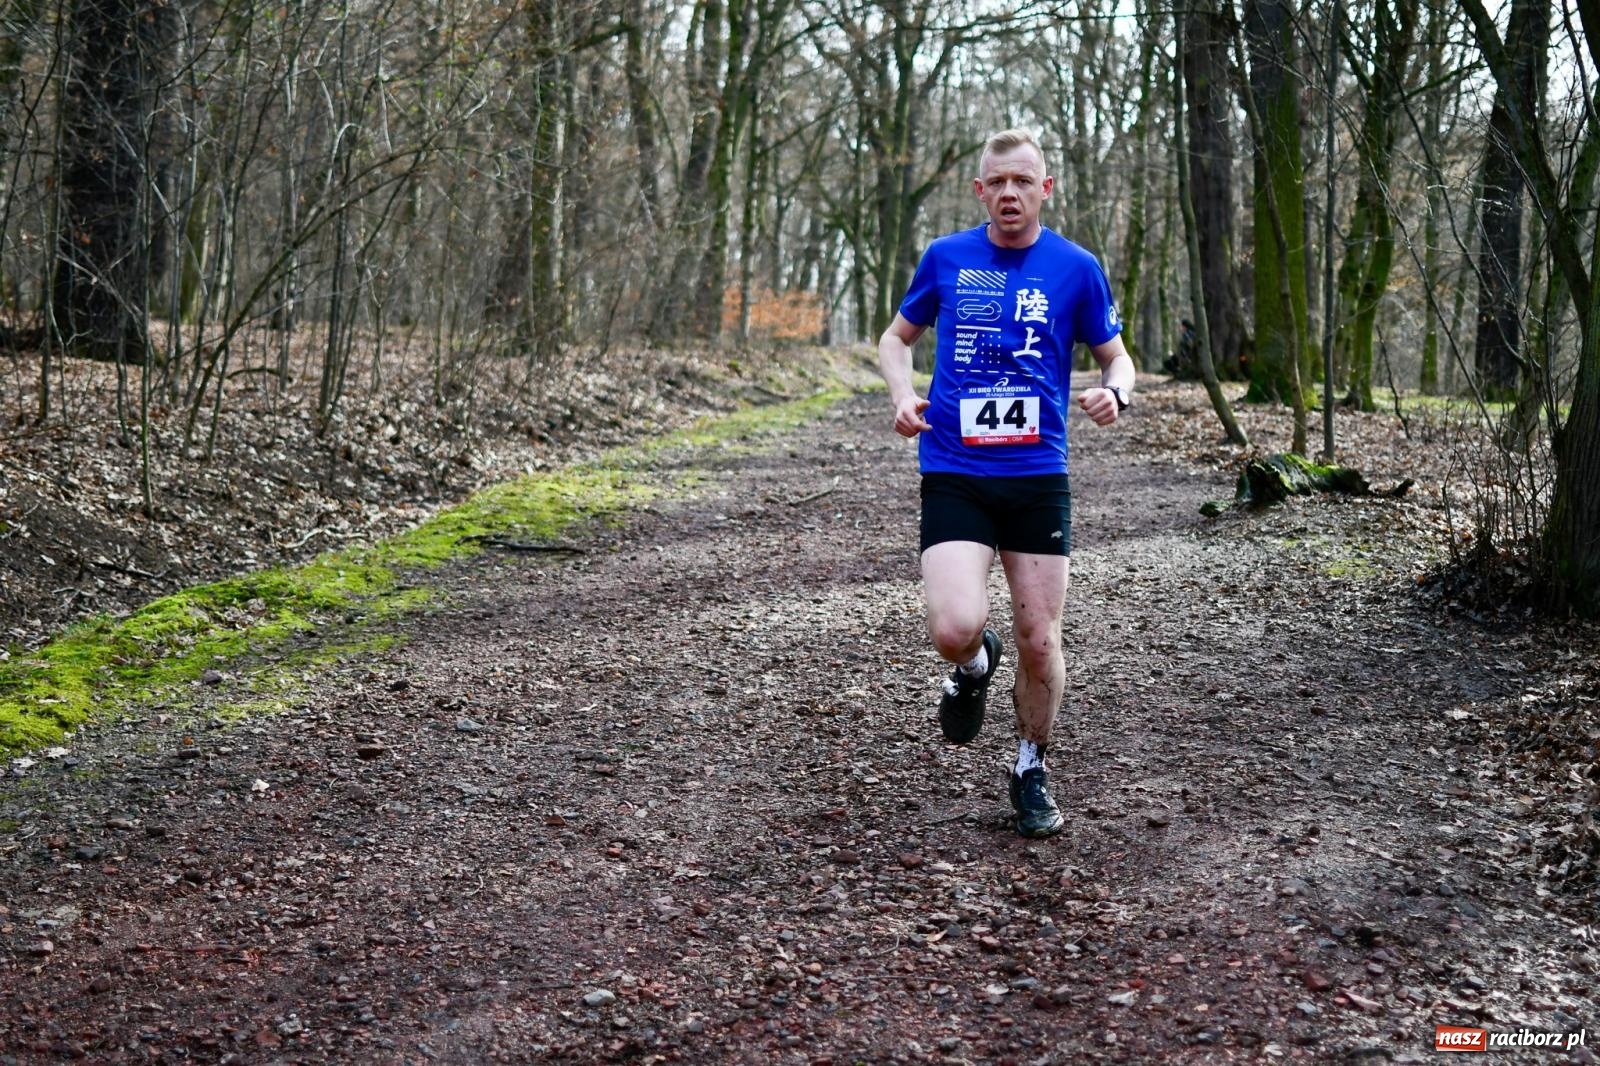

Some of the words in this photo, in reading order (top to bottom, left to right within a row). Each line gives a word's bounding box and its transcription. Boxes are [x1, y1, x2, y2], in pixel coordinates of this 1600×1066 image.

[1012, 288, 1049, 358] 陸上
[954, 354, 972, 364] body
[976, 399, 1027, 430] 44
